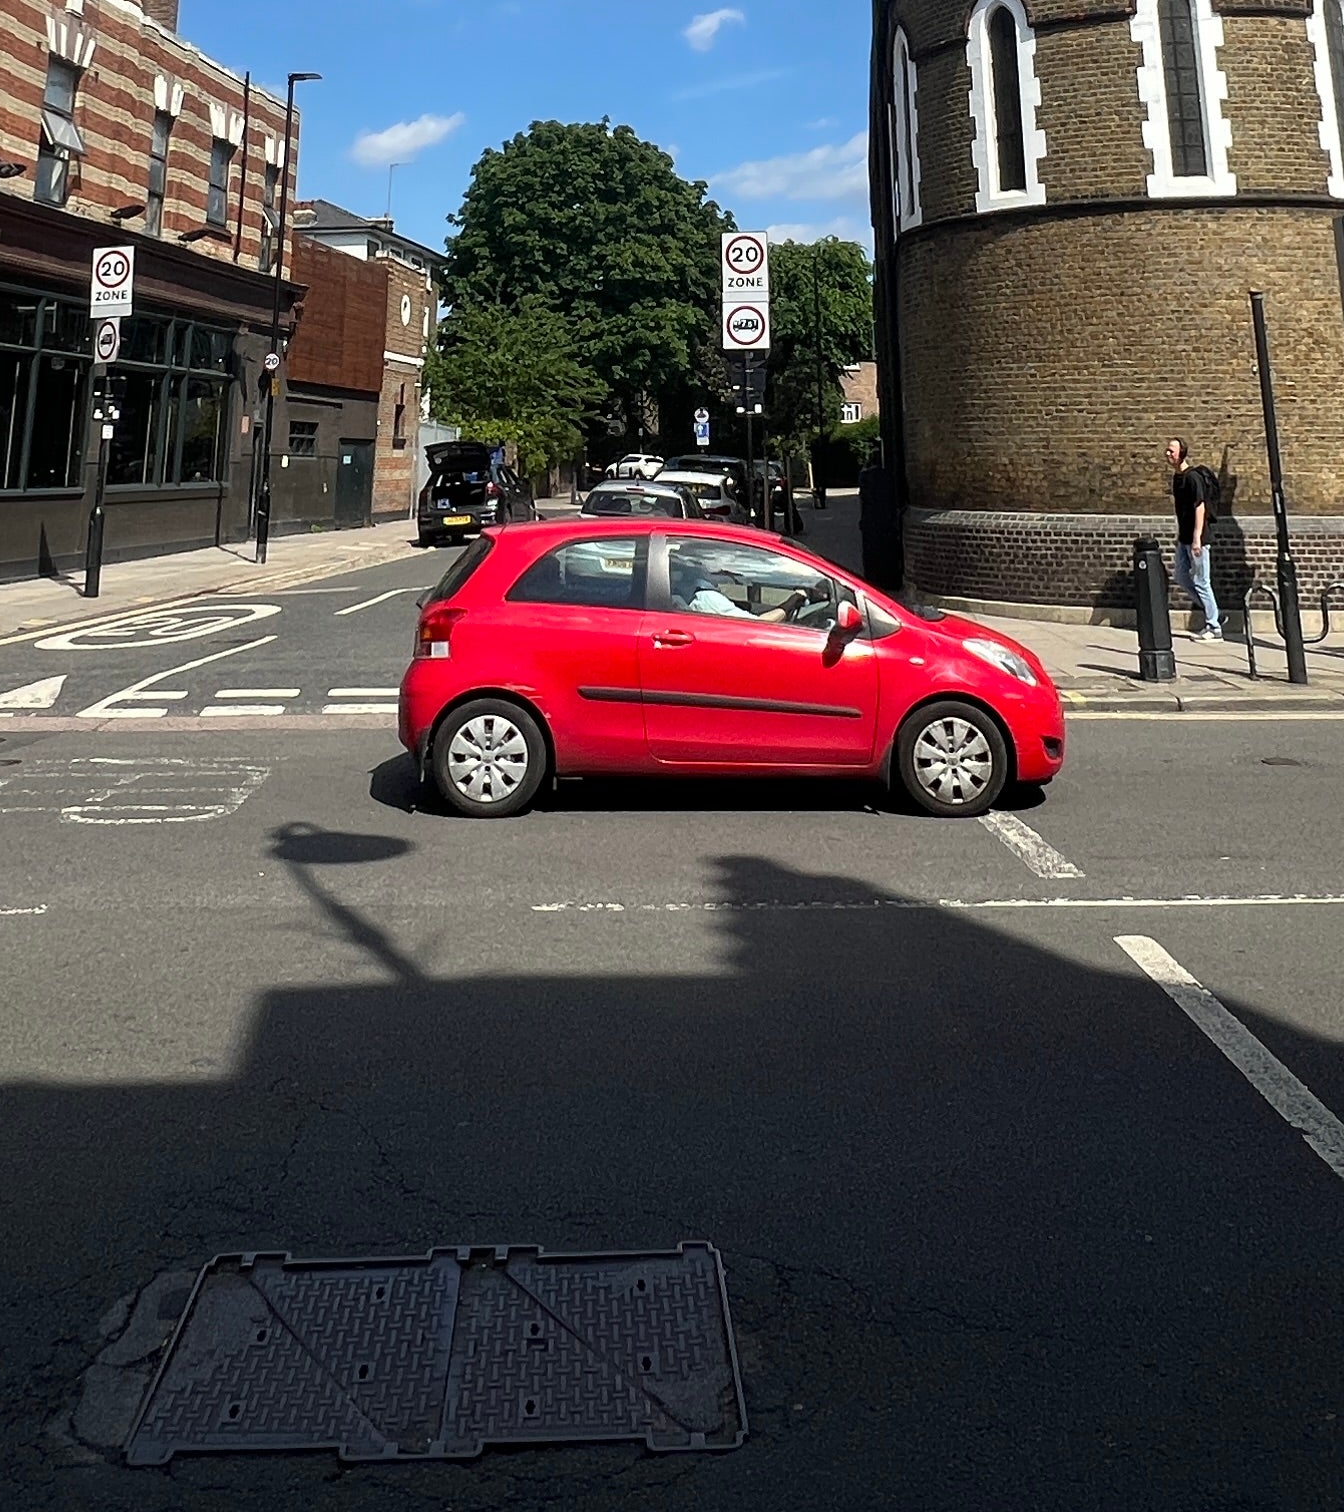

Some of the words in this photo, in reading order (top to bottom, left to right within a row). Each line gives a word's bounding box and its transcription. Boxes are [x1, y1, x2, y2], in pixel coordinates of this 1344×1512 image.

[731, 247, 759, 263] 20
[101, 260, 125, 277] 20
[727, 277, 764, 288] ZONE
[95, 290, 129, 302] ZONE
[266, 357, 278, 366] 20
